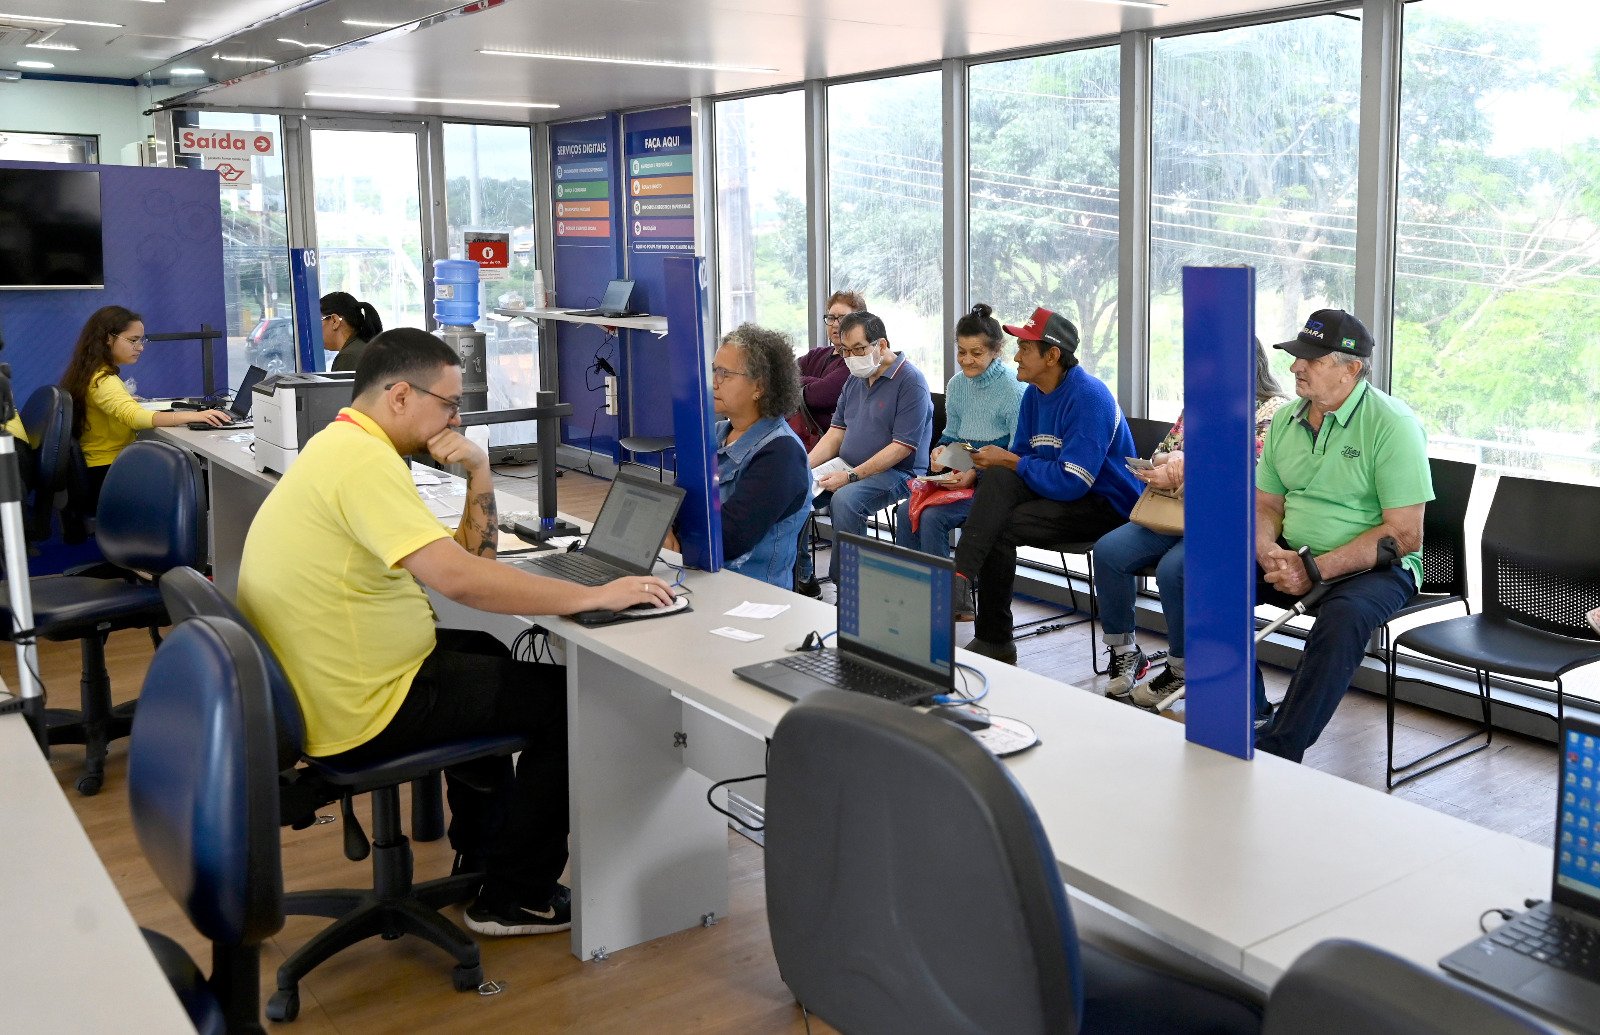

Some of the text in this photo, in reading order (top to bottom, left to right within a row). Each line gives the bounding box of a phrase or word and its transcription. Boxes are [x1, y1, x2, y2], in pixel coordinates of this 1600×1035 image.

[183, 132, 246, 150] Saída
[644, 135, 680, 151] FAÇA AQUI
[557, 142, 607, 157] SERVIÇOS DIGITAIS
[303, 250, 316, 267] 03
